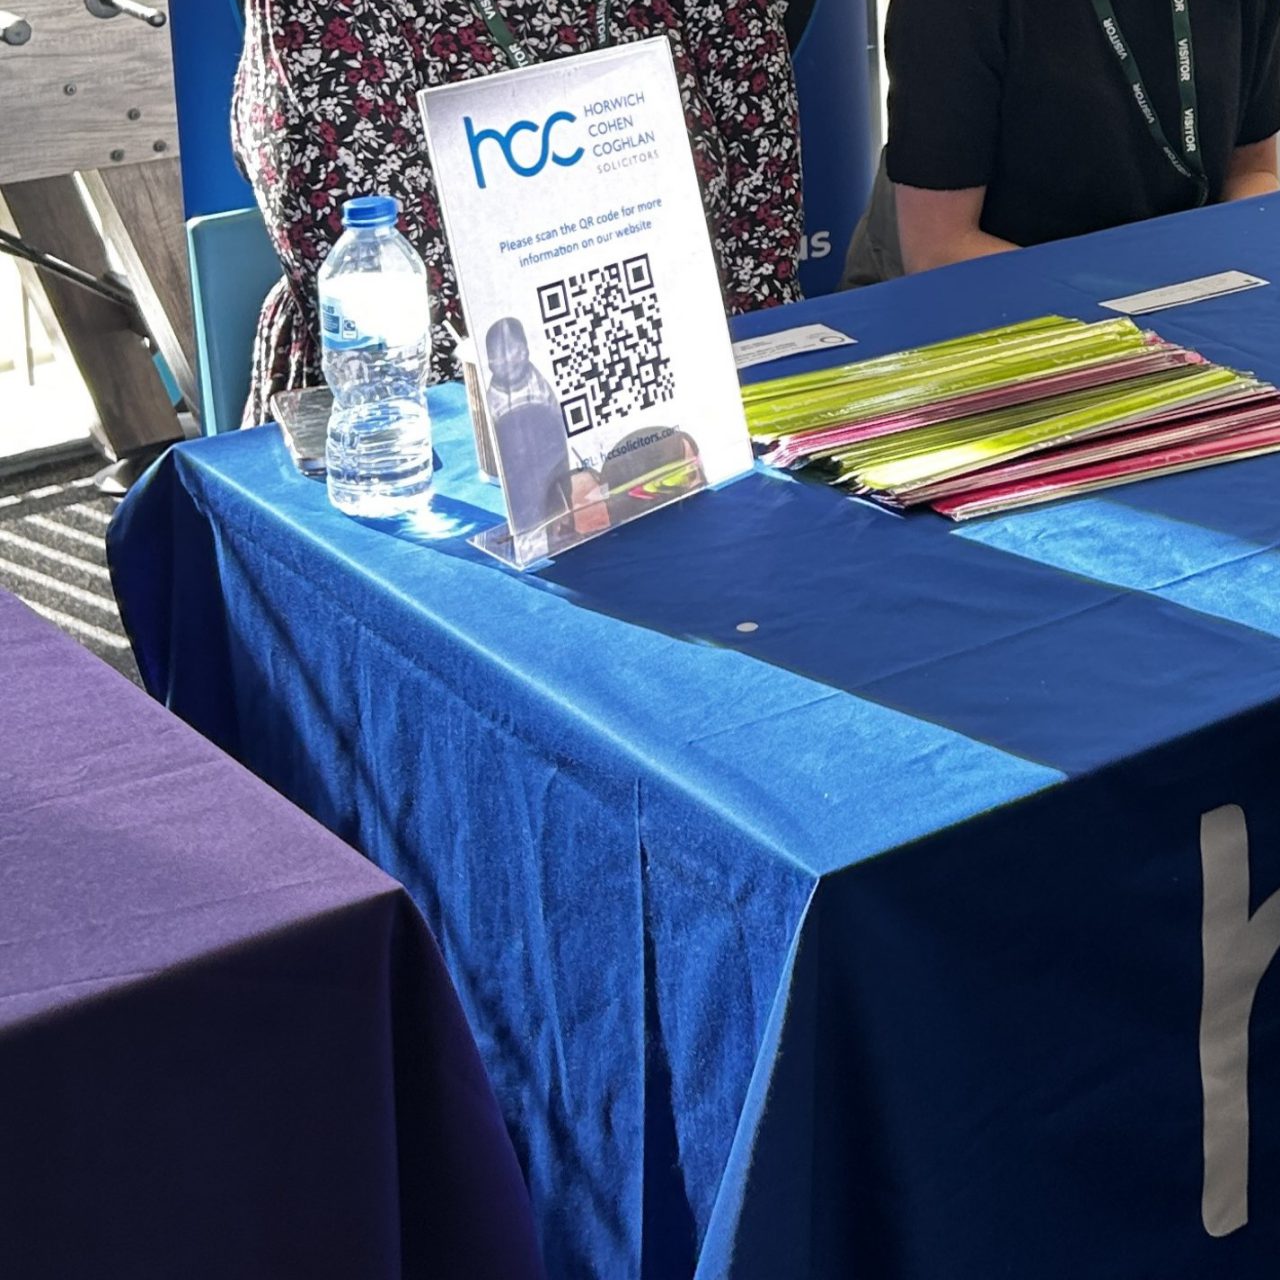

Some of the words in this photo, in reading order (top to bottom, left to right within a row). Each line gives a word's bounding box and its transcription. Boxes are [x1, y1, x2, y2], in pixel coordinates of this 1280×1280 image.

[1103, 17, 1126, 61] VISITOR
[1178, 38, 1191, 82] VISITOR
[583, 91, 645, 117] HORWICH
[588, 114, 633, 137] COHEN
[1132, 83, 1155, 124] VISITOR
[464, 110, 585, 189] hcc
[592, 130, 655, 157] COGHLAN
[1184, 108, 1196, 152] VISITOR
[596, 149, 660, 174] SOLICITORS
[499, 236, 533, 253] Please
[535, 228, 559, 243] scan
[560, 222, 577, 236] the
[579, 216, 594, 230] QR
[596, 210, 619, 224] code
[621, 205, 635, 218] for
[637, 198, 662, 213] more
[519, 242, 580, 268] information
[581, 238, 594, 249] on
[596, 232, 613, 245] our
[615, 220, 652, 238] website
